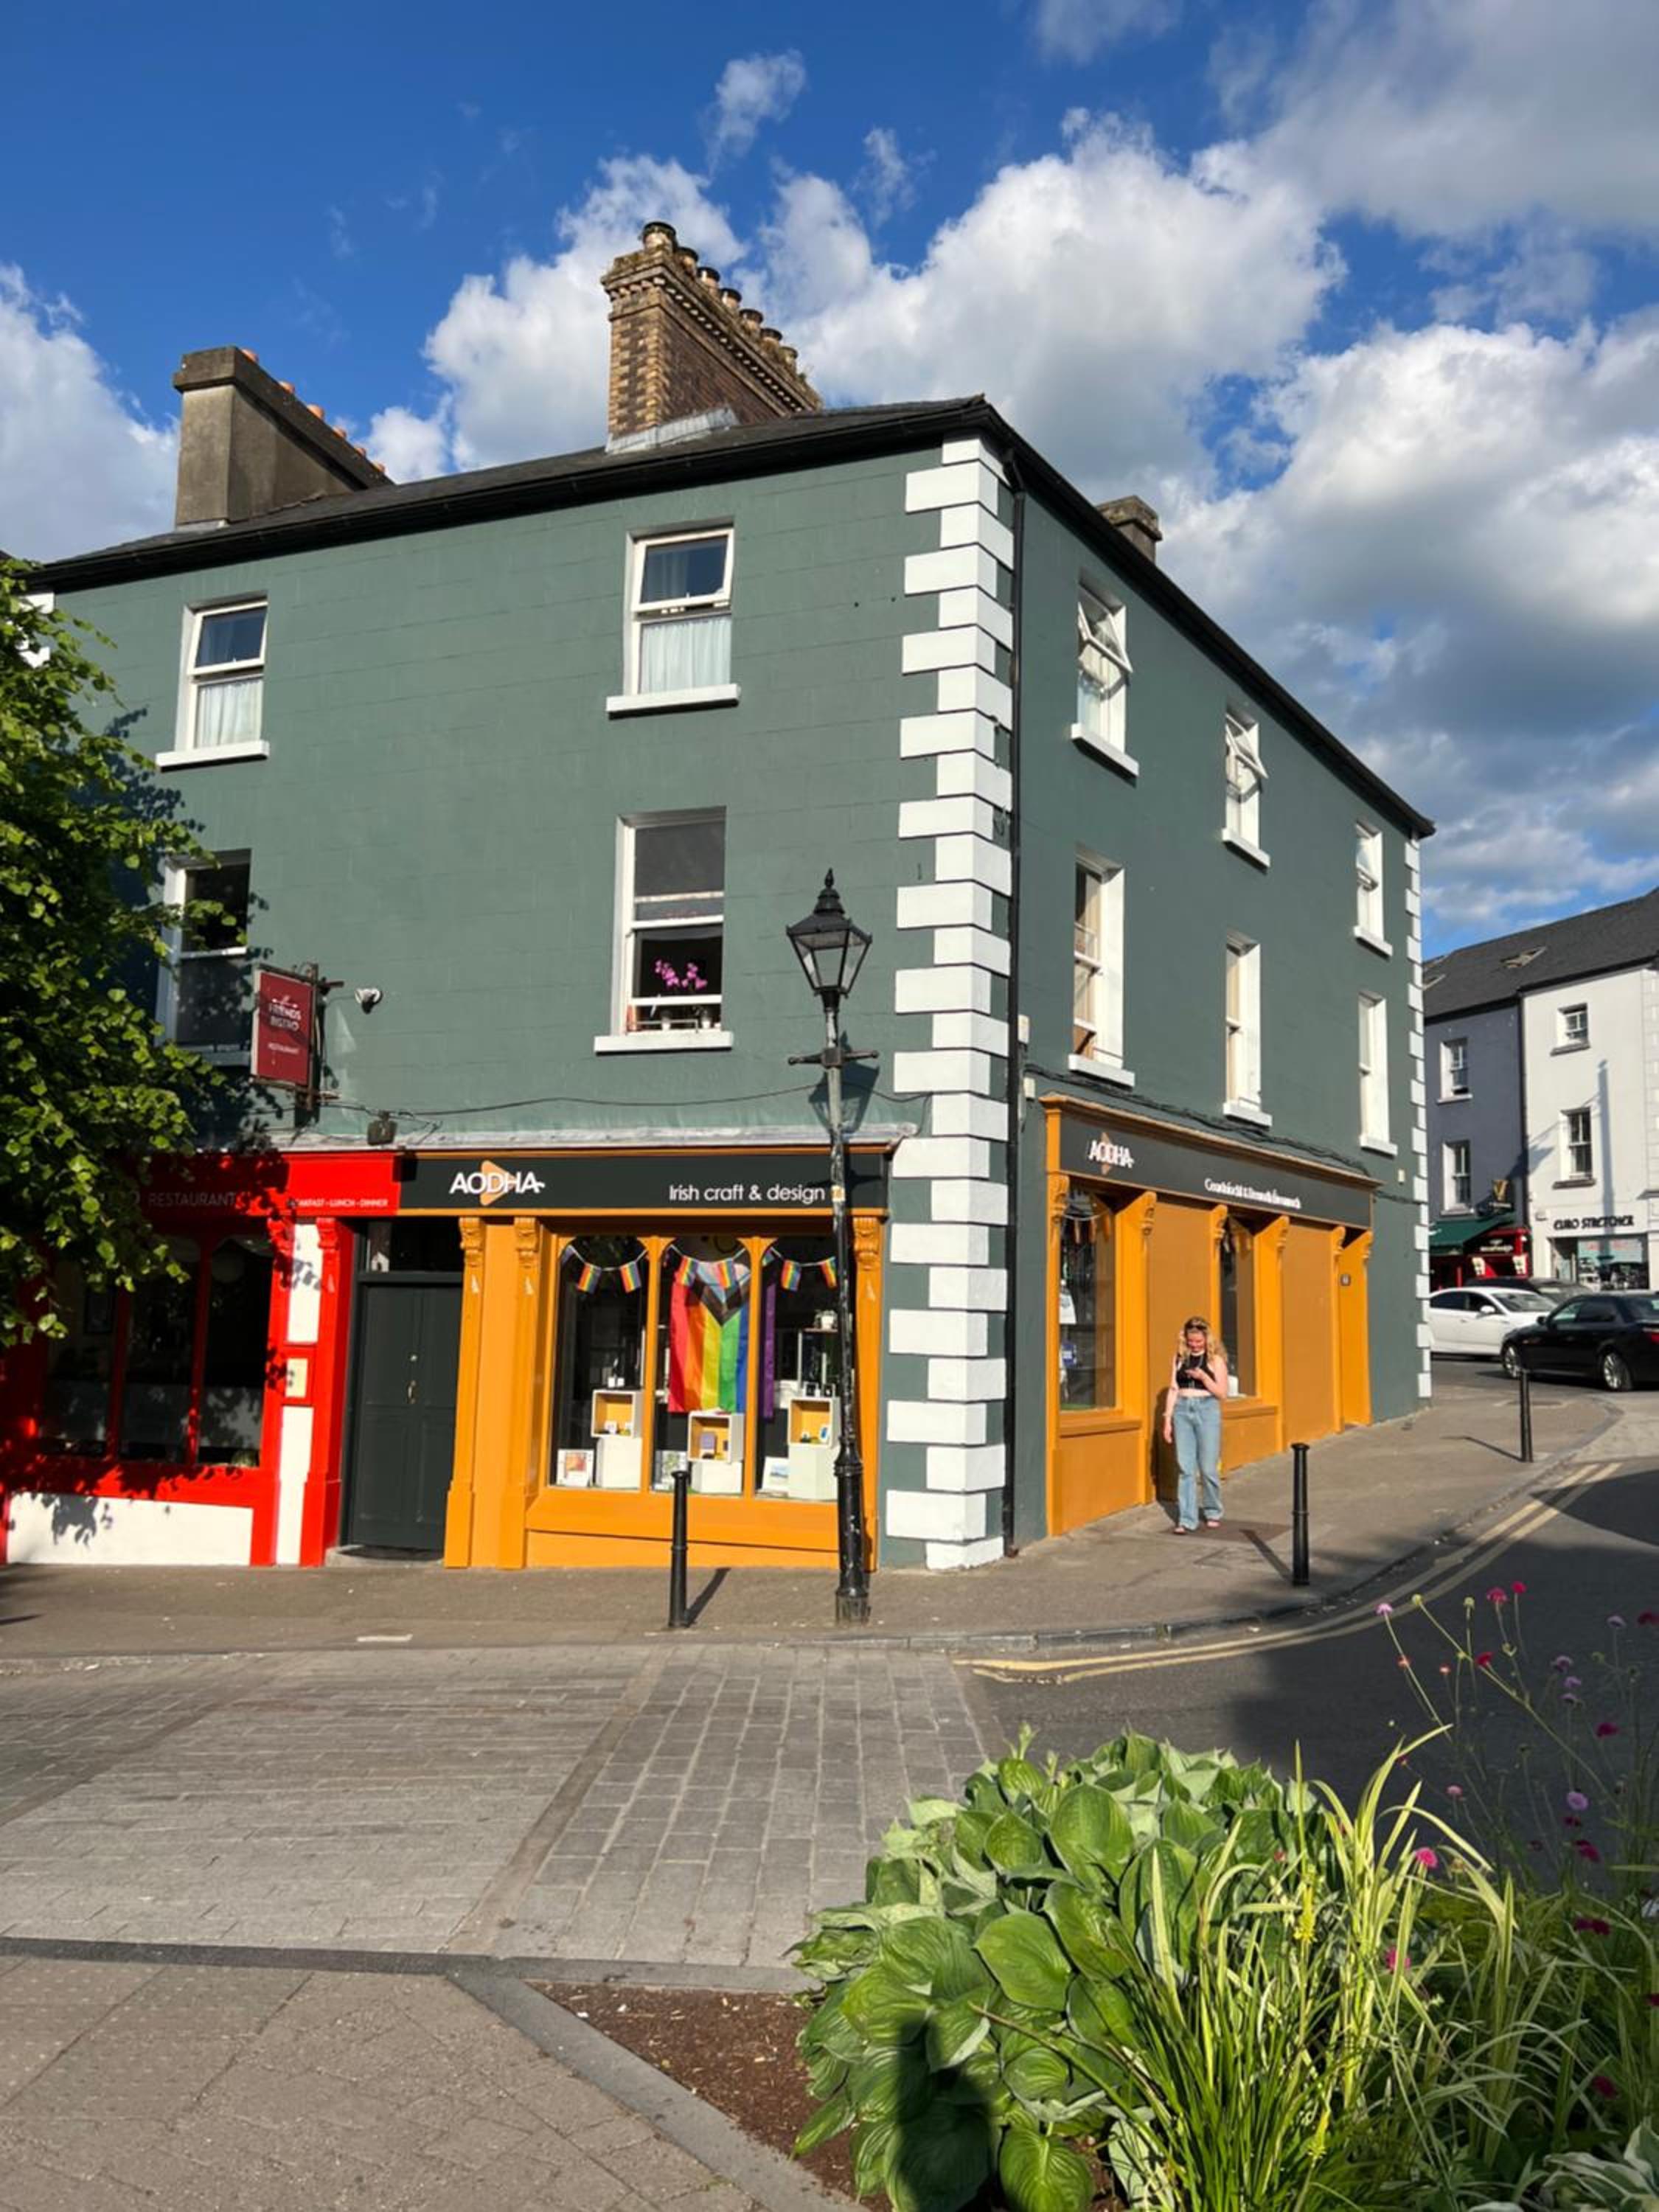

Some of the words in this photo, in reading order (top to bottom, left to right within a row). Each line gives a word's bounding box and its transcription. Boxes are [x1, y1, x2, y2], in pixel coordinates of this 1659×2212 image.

[1088, 1139, 1135, 1169] AODHA
[449, 1171, 546, 1194] AODHA
[149, 1192, 237, 1206] RESTAURANT
[669, 1184, 700, 1201] Irish
[703, 1183, 744, 1201] craft
[748, 1184, 762, 1201] &
[767, 1183, 826, 1205] design
